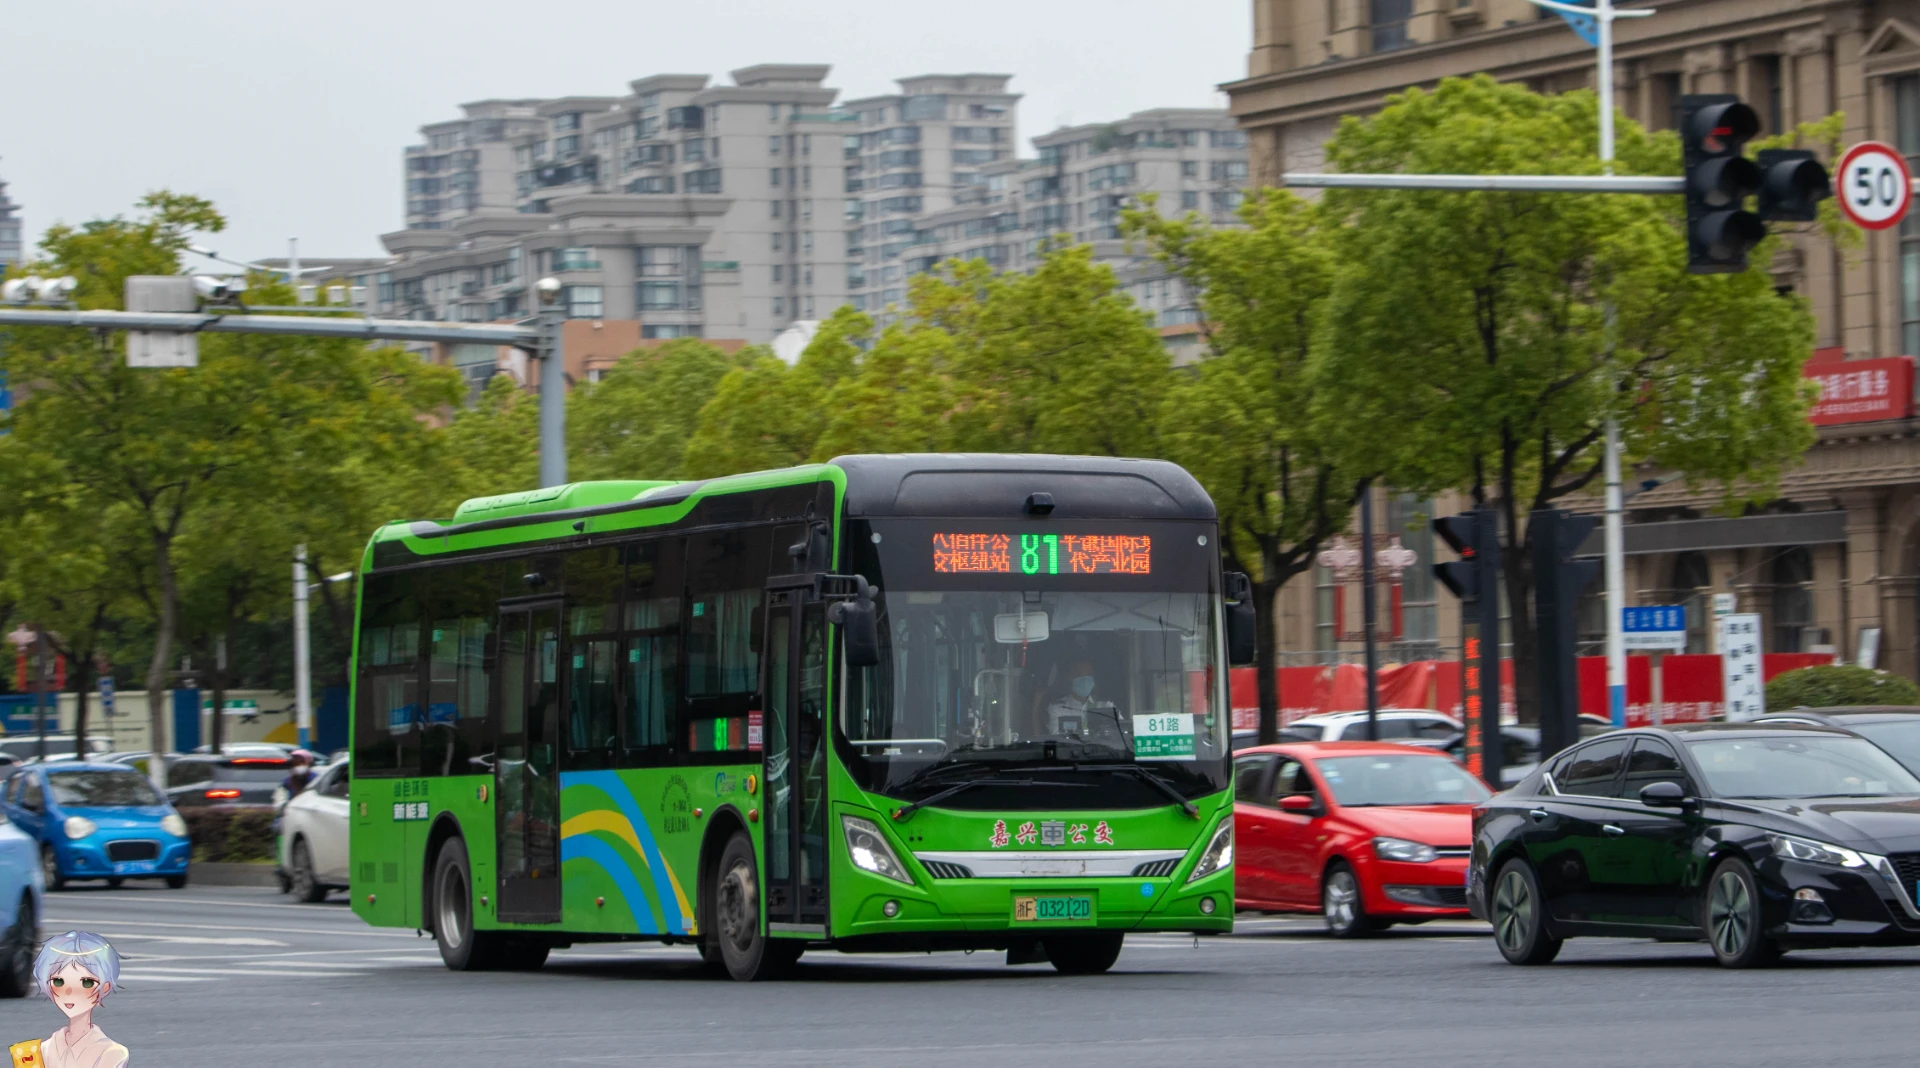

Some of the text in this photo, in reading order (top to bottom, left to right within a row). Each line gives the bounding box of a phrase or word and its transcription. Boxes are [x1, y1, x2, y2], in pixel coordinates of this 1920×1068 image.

[1856, 167, 1897, 207] 50
[1020, 533, 1059, 575] 81
[1069, 552, 1150, 574] 代产业园
[1148, 717, 1179, 732] 81路
